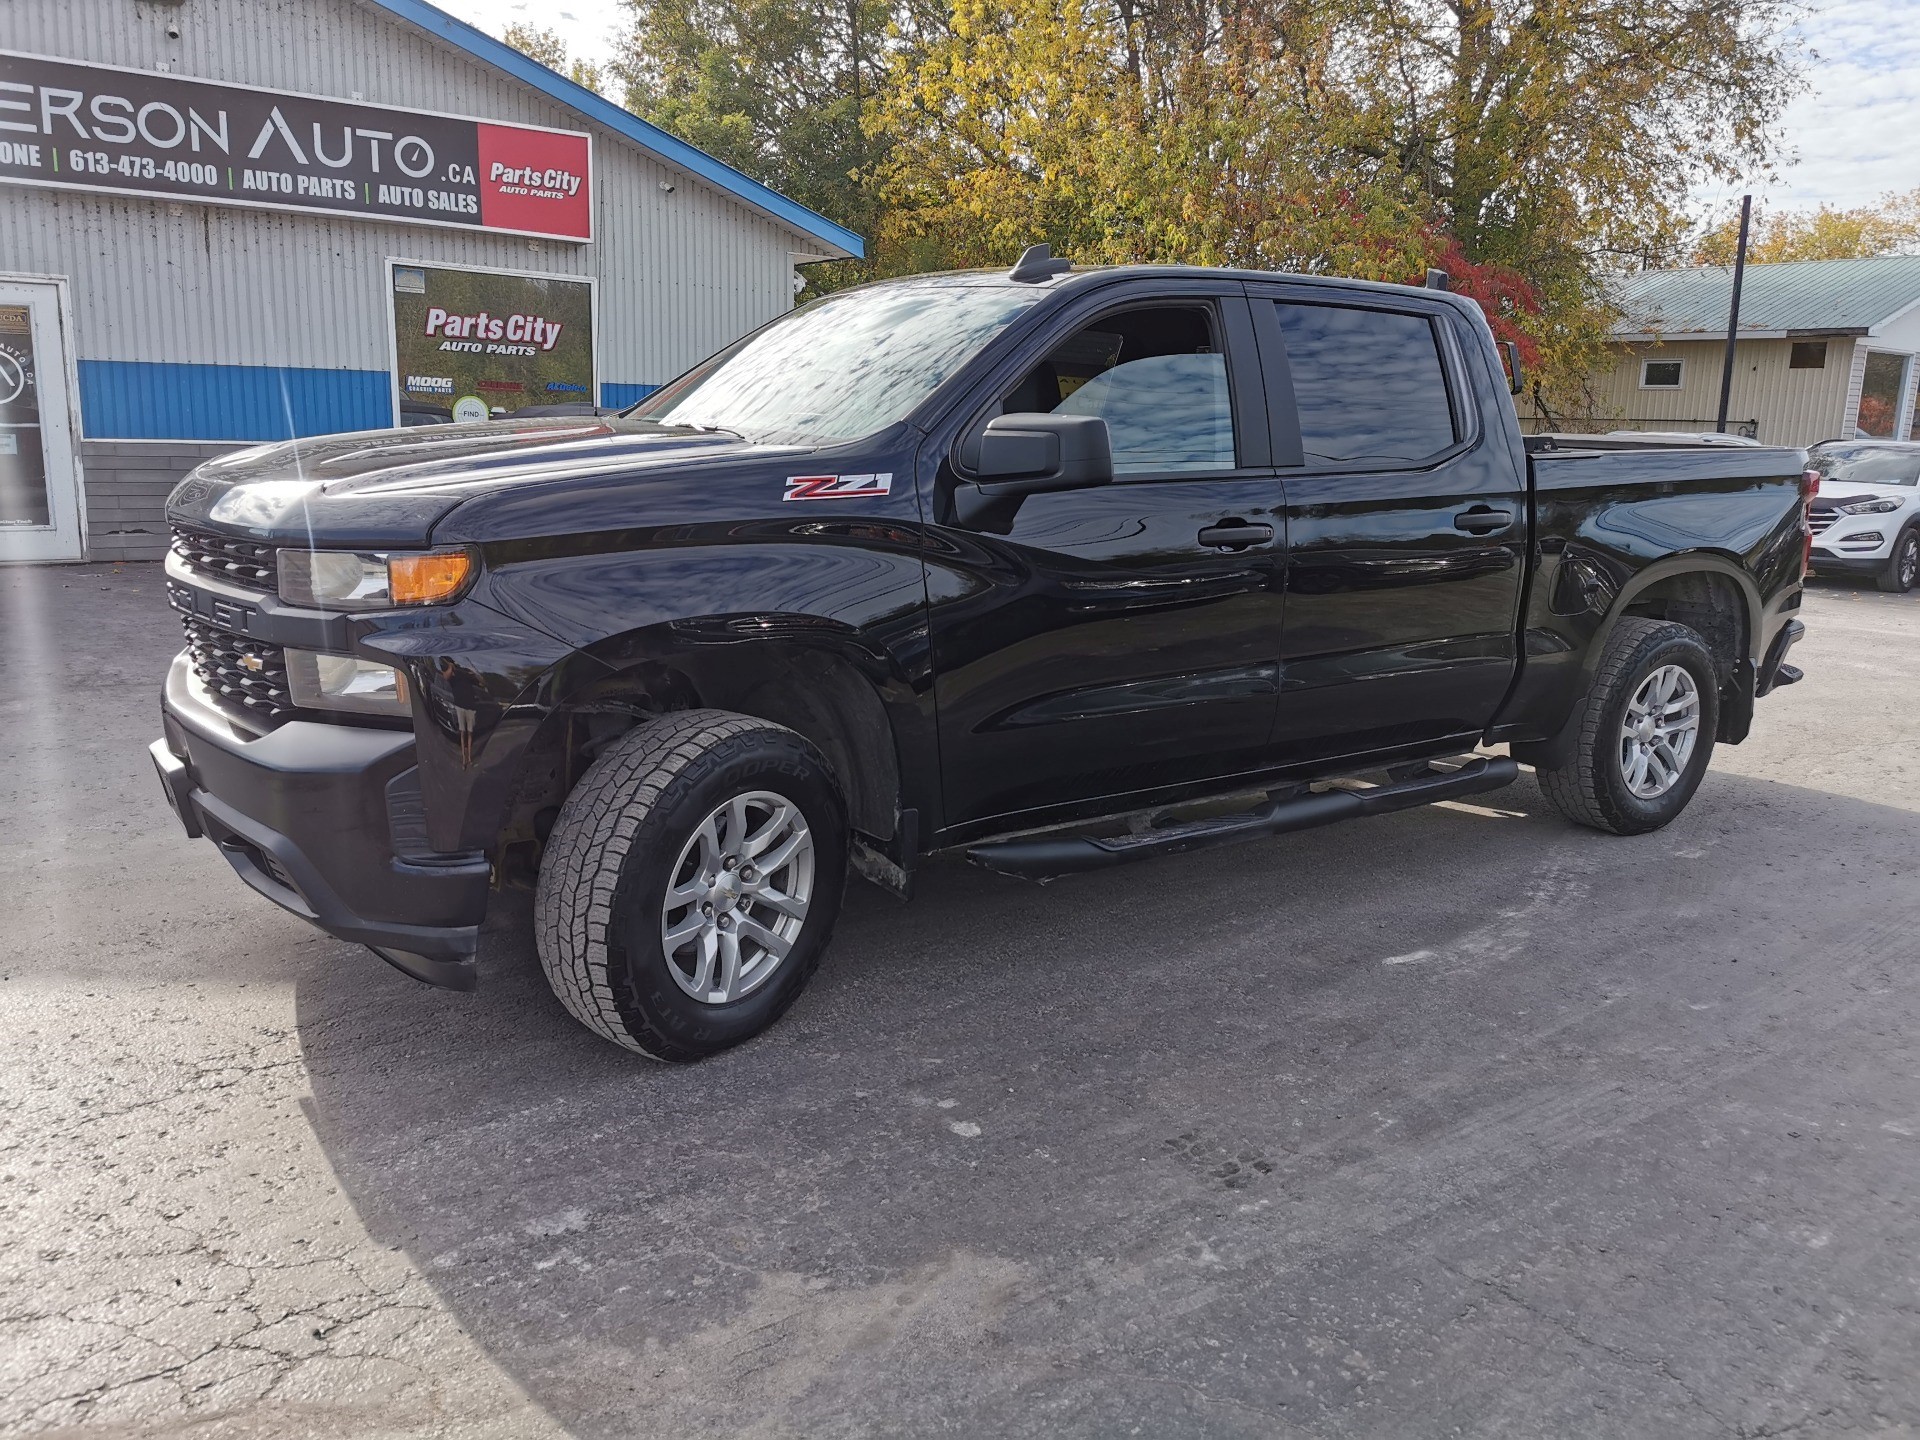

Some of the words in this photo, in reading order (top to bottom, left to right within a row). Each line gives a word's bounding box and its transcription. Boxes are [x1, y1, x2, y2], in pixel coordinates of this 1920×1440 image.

[69, 149, 218, 186] 613-473-4000
[242, 169, 293, 194] AUTO
[297, 174, 356, 200] PARTS
[378, 184, 424, 208] AUTO
[428, 189, 478, 214] SALES
[499, 185, 527, 195] AUTO
[530, 189, 564, 199] PARTS
[439, 341, 482, 353] AUTO
[486, 344, 536, 356] PARTS
[407, 375, 453, 388] MOOG
[463, 410, 480, 418] FIND
[782, 472, 893, 502] Z71
